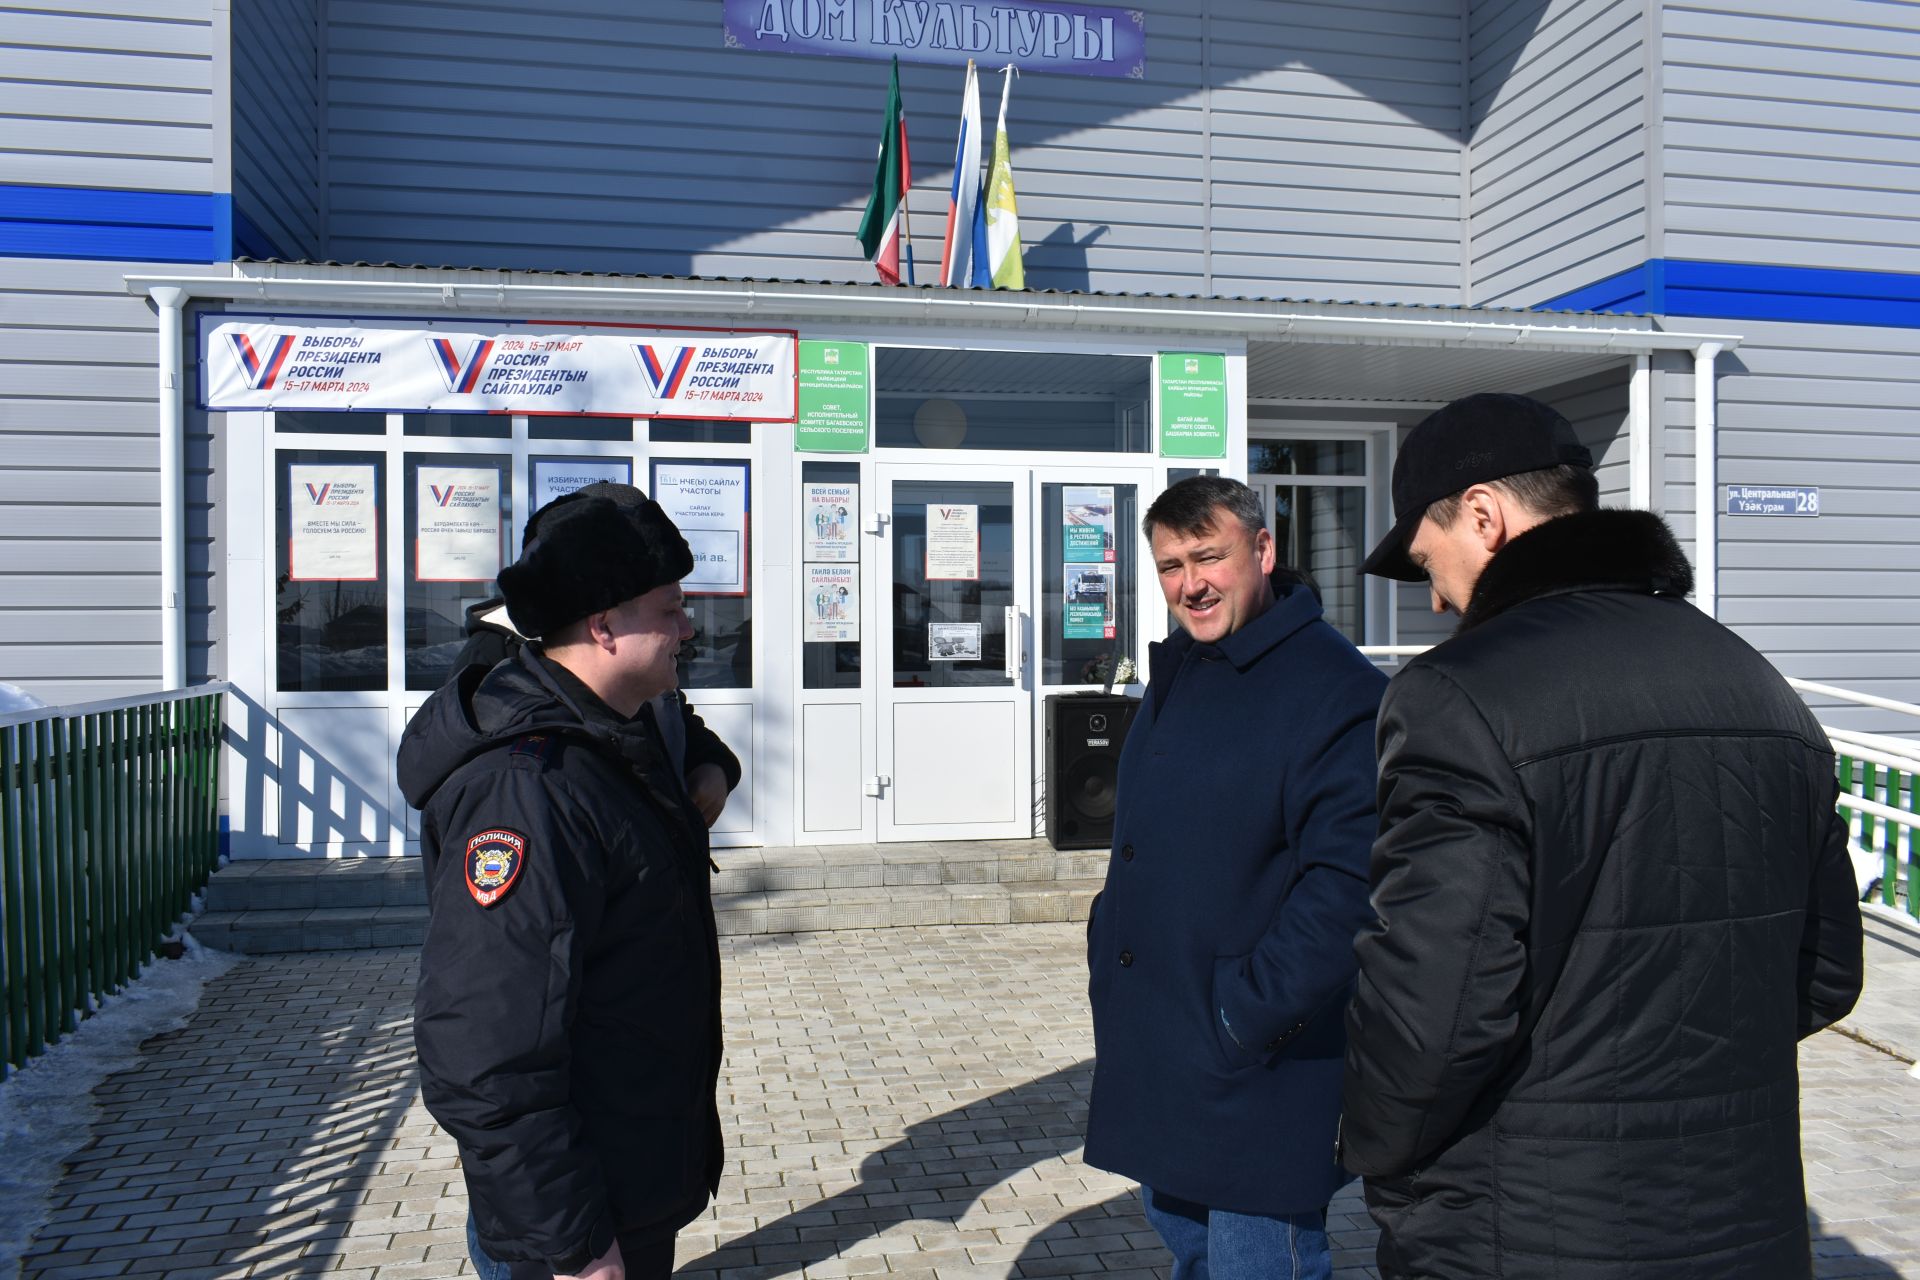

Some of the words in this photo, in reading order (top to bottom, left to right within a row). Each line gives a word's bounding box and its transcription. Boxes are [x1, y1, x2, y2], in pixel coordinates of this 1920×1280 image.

[756, 0, 857, 42] ДОМ
[870, 0, 1116, 62] КУЛЬТУРЫ
[302, 336, 364, 348] ВЫБОРЫ
[501, 340, 525, 351] 2024
[555, 342, 583, 352] МАРТ
[294, 350, 382, 365] ПРЕЗИДЕНТА
[494, 353, 550, 366] РОССИЯ
[701, 347, 759, 360] ВЫБОРЫ
[287, 365, 345, 379] РОССИИ
[695, 361, 775, 375] ПРЕЗИДЕНТА
[487, 368, 588, 382] ПРЕЗИДЕНТЫН
[311, 381, 345, 392] МАРТА
[345, 382, 370, 393] 2024
[481, 381, 563, 396] САЙЛАУЛАР
[688, 376, 741, 389] РОССИИ
[709, 391, 741, 401] МАРТА
[741, 392, 764, 402] 2024
[679, 478, 707, 487] НЧЕ(Ы)
[708, 478, 740, 487] САЙЛАУ
[679, 487, 721, 495] УЧАСТОГЫ
[1729, 490, 1740, 500] ул.
[1741, 488, 1796, 500] Центральная
[1797, 492, 1818, 512] 28
[1763, 504, 1785, 513] урам
[470, 832, 521, 850] ПОЛИЦИЯ
[476, 890, 497, 904] МВД
